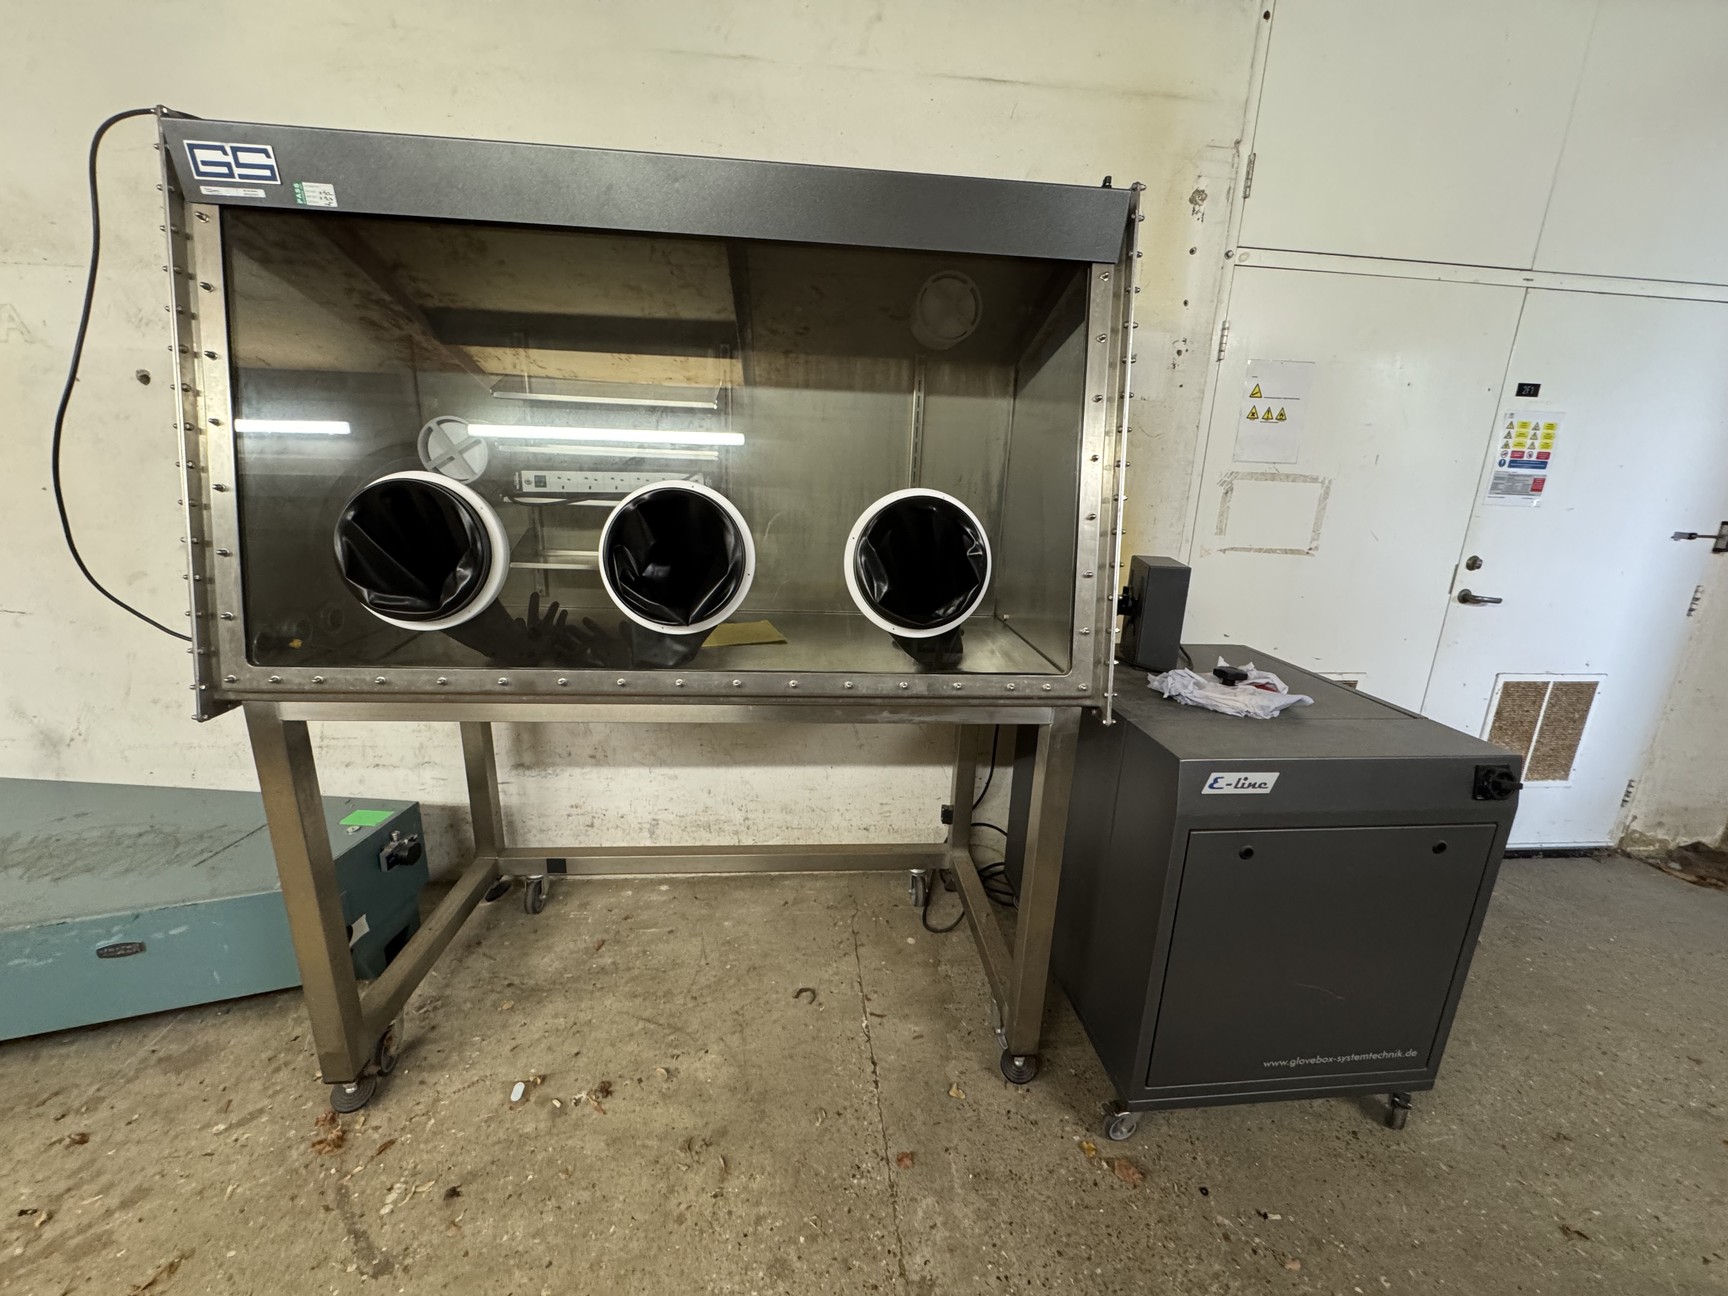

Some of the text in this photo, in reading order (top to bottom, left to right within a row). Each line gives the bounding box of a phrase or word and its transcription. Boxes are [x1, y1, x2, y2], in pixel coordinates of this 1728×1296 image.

[186, 143, 278, 182] GS
[1208, 776, 1269, 790] E-line
[1263, 1049, 1418, 1068] www.glovebox-systemtechnik.de
